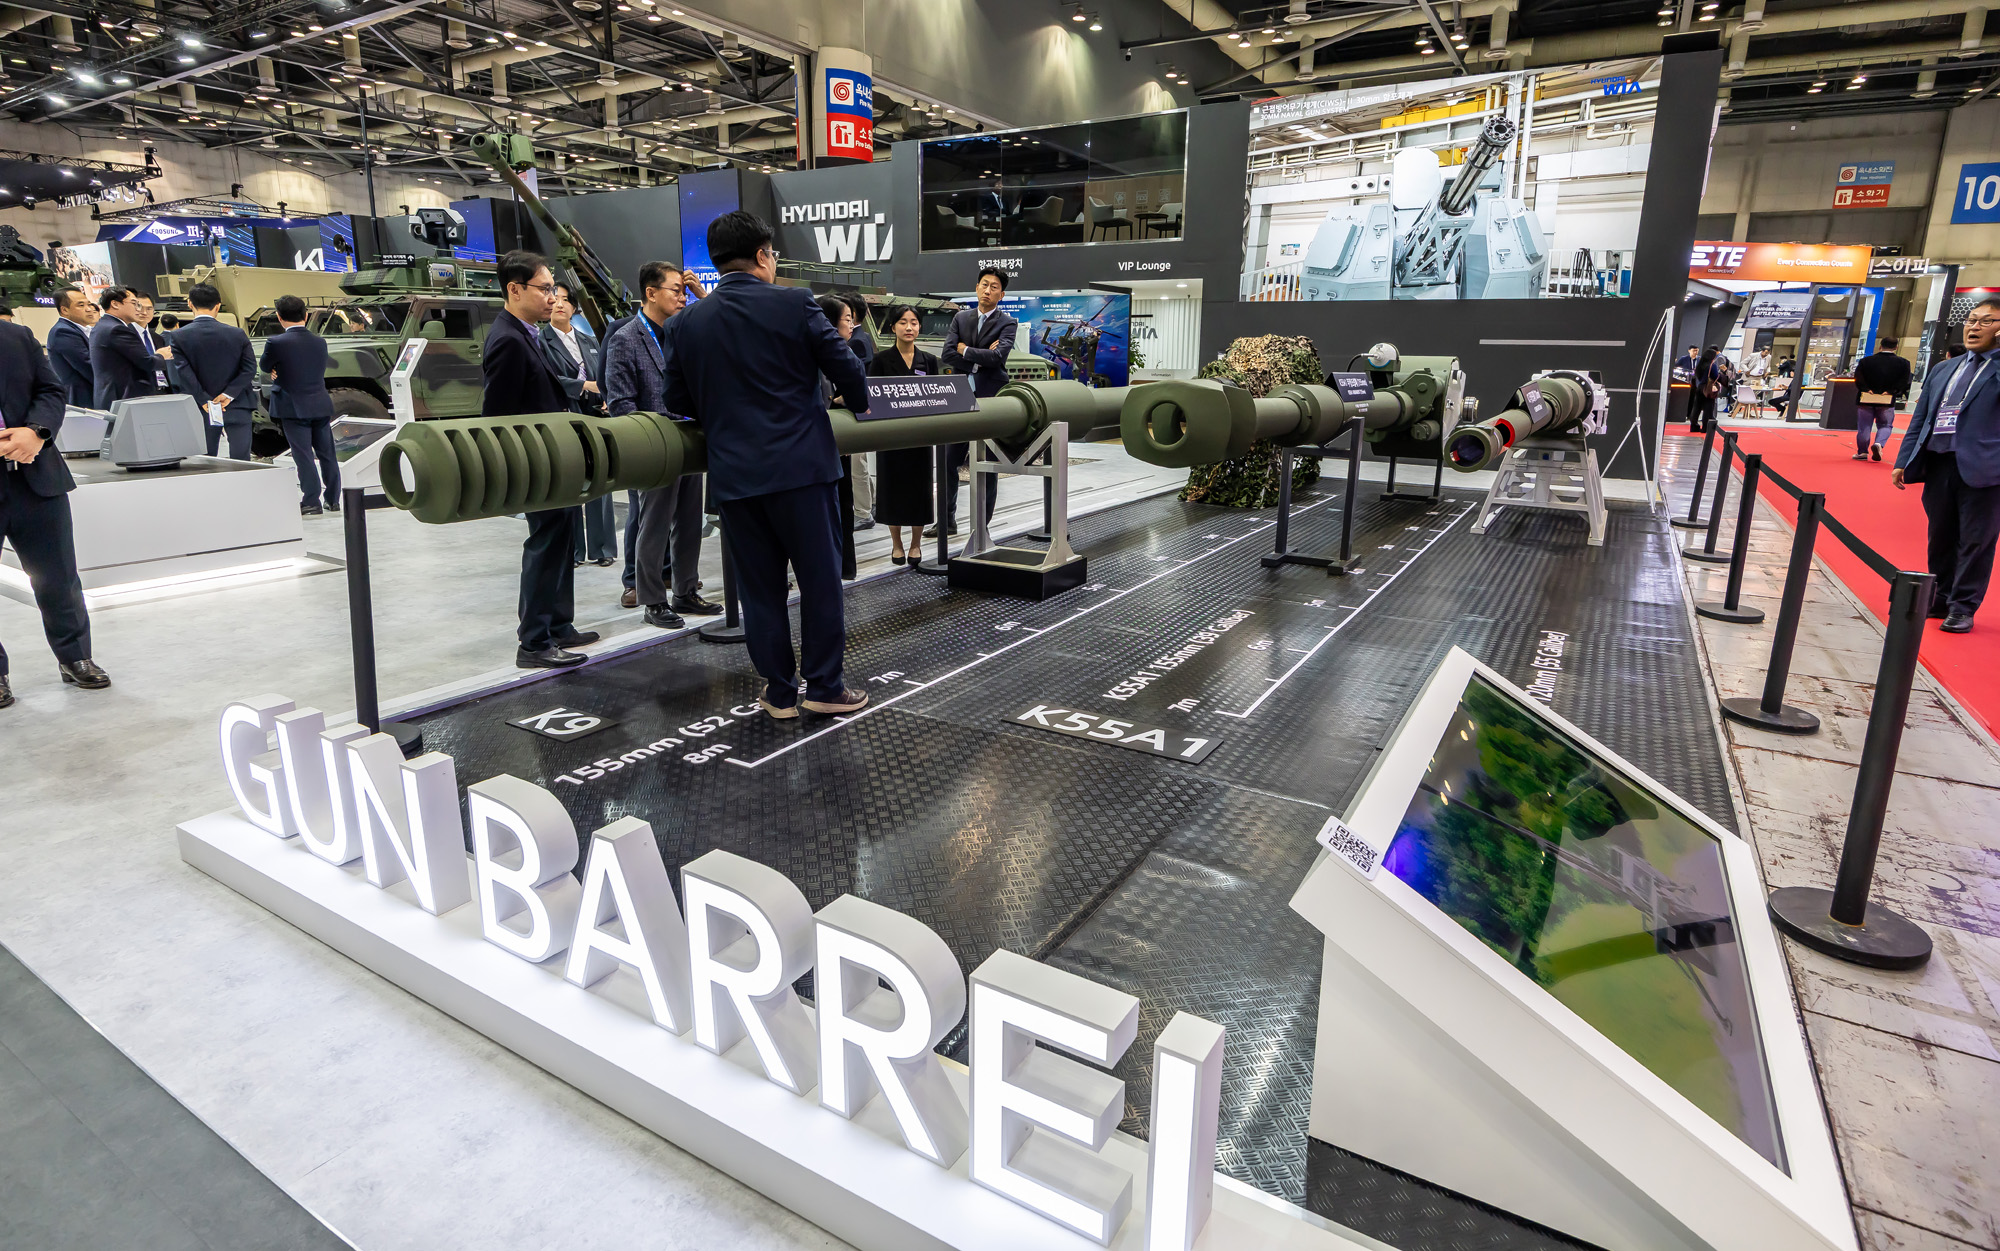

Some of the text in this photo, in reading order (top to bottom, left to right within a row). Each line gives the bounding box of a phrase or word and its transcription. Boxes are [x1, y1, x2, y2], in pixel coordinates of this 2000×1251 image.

[1590, 76, 1626, 85] HYUNDAI
[1603, 79, 1642, 96] WIA
[1356, 95, 1380, 105] 30mm
[1260, 106, 1350, 121] 30MM NAVAL GUN SYSTEM
[1964, 175, 2000, 210] 10
[781, 200, 870, 224] HYUNDAI
[1715, 246, 1748, 268] TE
[1777, 258, 1853, 267] Every Connection Counts
[1118, 261, 1171, 272] VIP Lounge
[868, 385, 882, 398] K9
[921, 381, 957, 396] (155mm)
[890, 398, 948, 409] K9 ARMAMENT (155mm)
[994, 620, 1021, 632] 6m
[1102, 663, 1162, 701] K55A1
[1149, 638, 1205, 671] 155mm
[1208, 609, 1256, 637] Caliber)
[868, 668, 905, 685] 7m
[1167, 697, 1201, 713] 7m
[517, 706, 602, 736] K9
[1017, 704, 1209, 758] K55A1
[553, 714, 735, 786] 155mm (52
[682, 743, 733, 765] 8m
[219, 693, 472, 917] GUN
